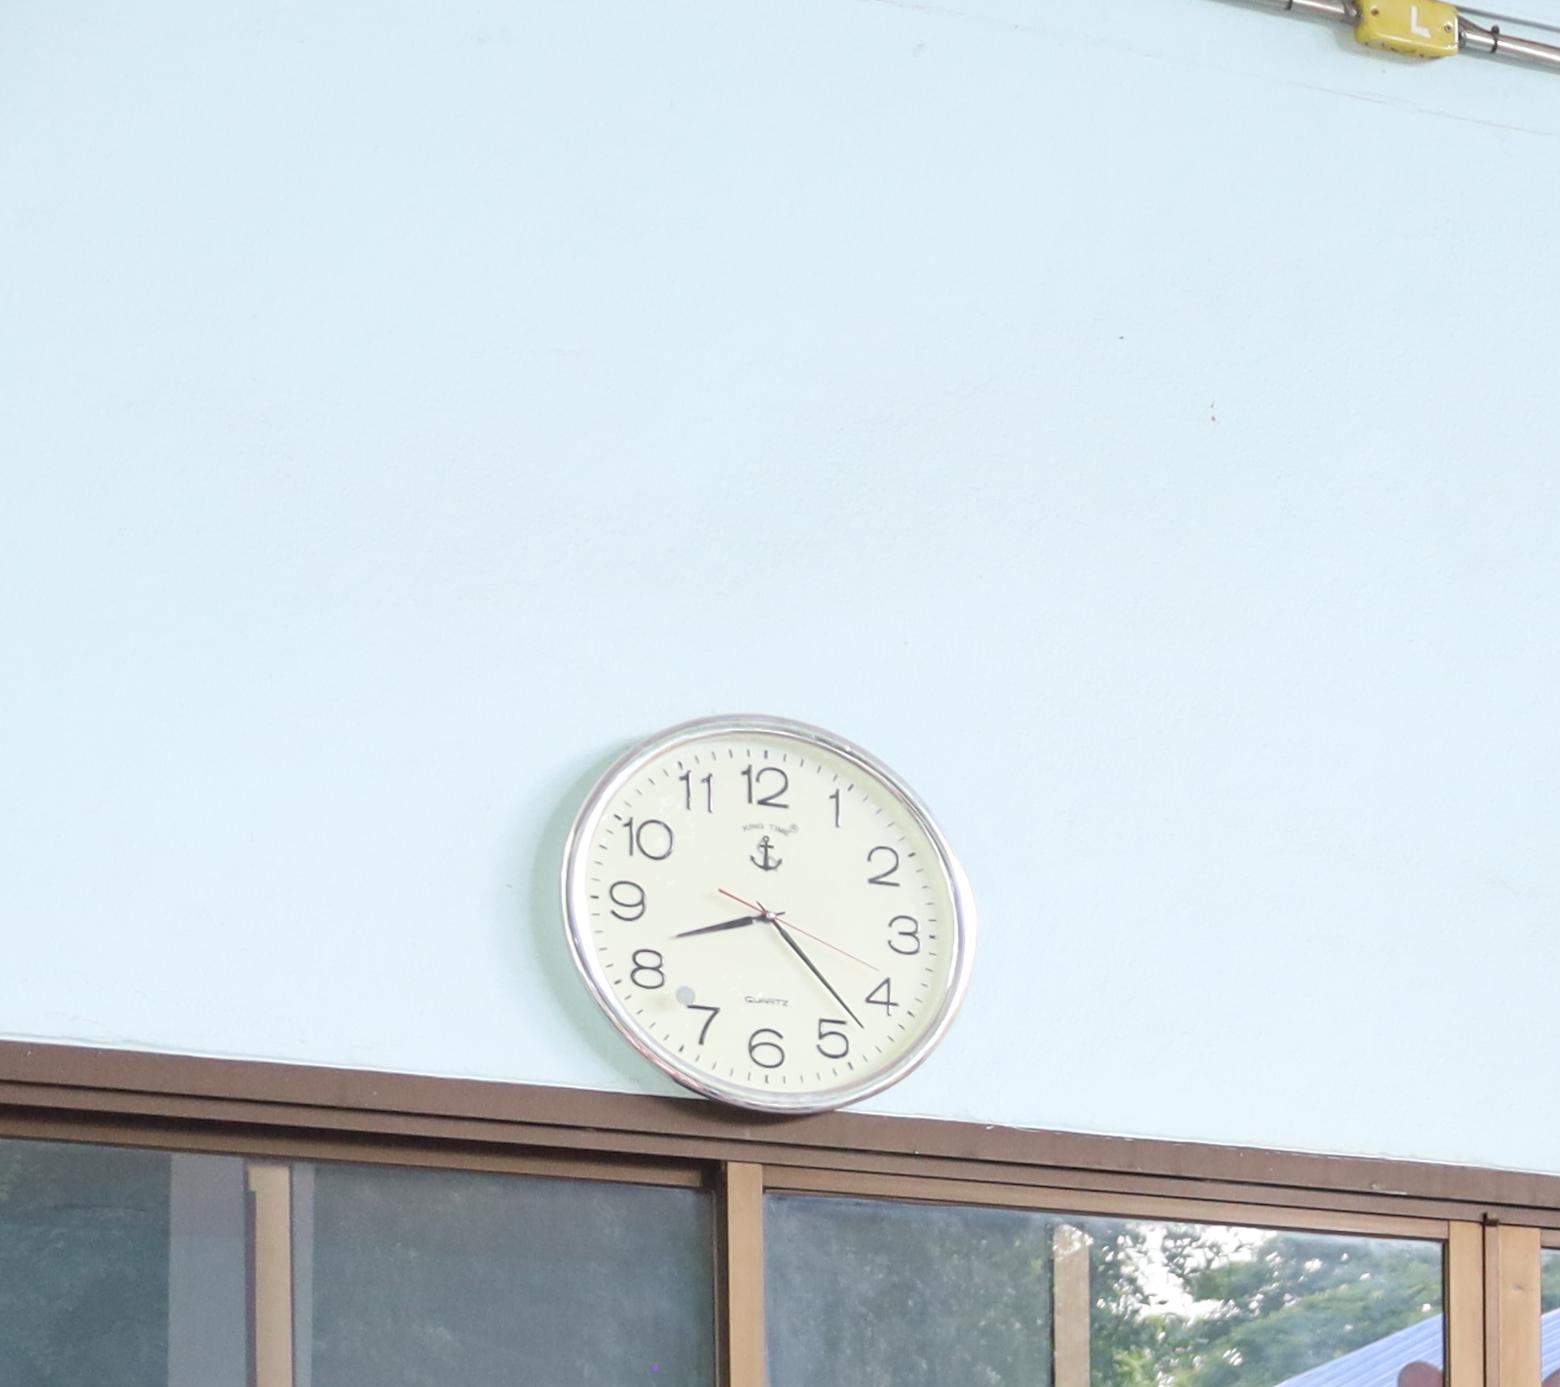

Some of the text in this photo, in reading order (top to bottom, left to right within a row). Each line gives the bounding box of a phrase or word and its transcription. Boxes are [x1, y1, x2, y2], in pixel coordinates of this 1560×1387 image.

[679, 769, 713, 814] 11
[741, 764, 790, 809] 12
[828, 788, 841, 828] 1
[621, 816, 674, 861] 10
[866, 845, 901, 887] 2
[608, 880, 646, 922] 9
[886, 915, 921, 956] 3
[629, 948, 666, 990] 8
[864, 977, 900, 1017] 4
[686, 1004, 721, 1046] 7
[816, 1017, 850, 1060] 5
[747, 1028, 785, 1069] 6
